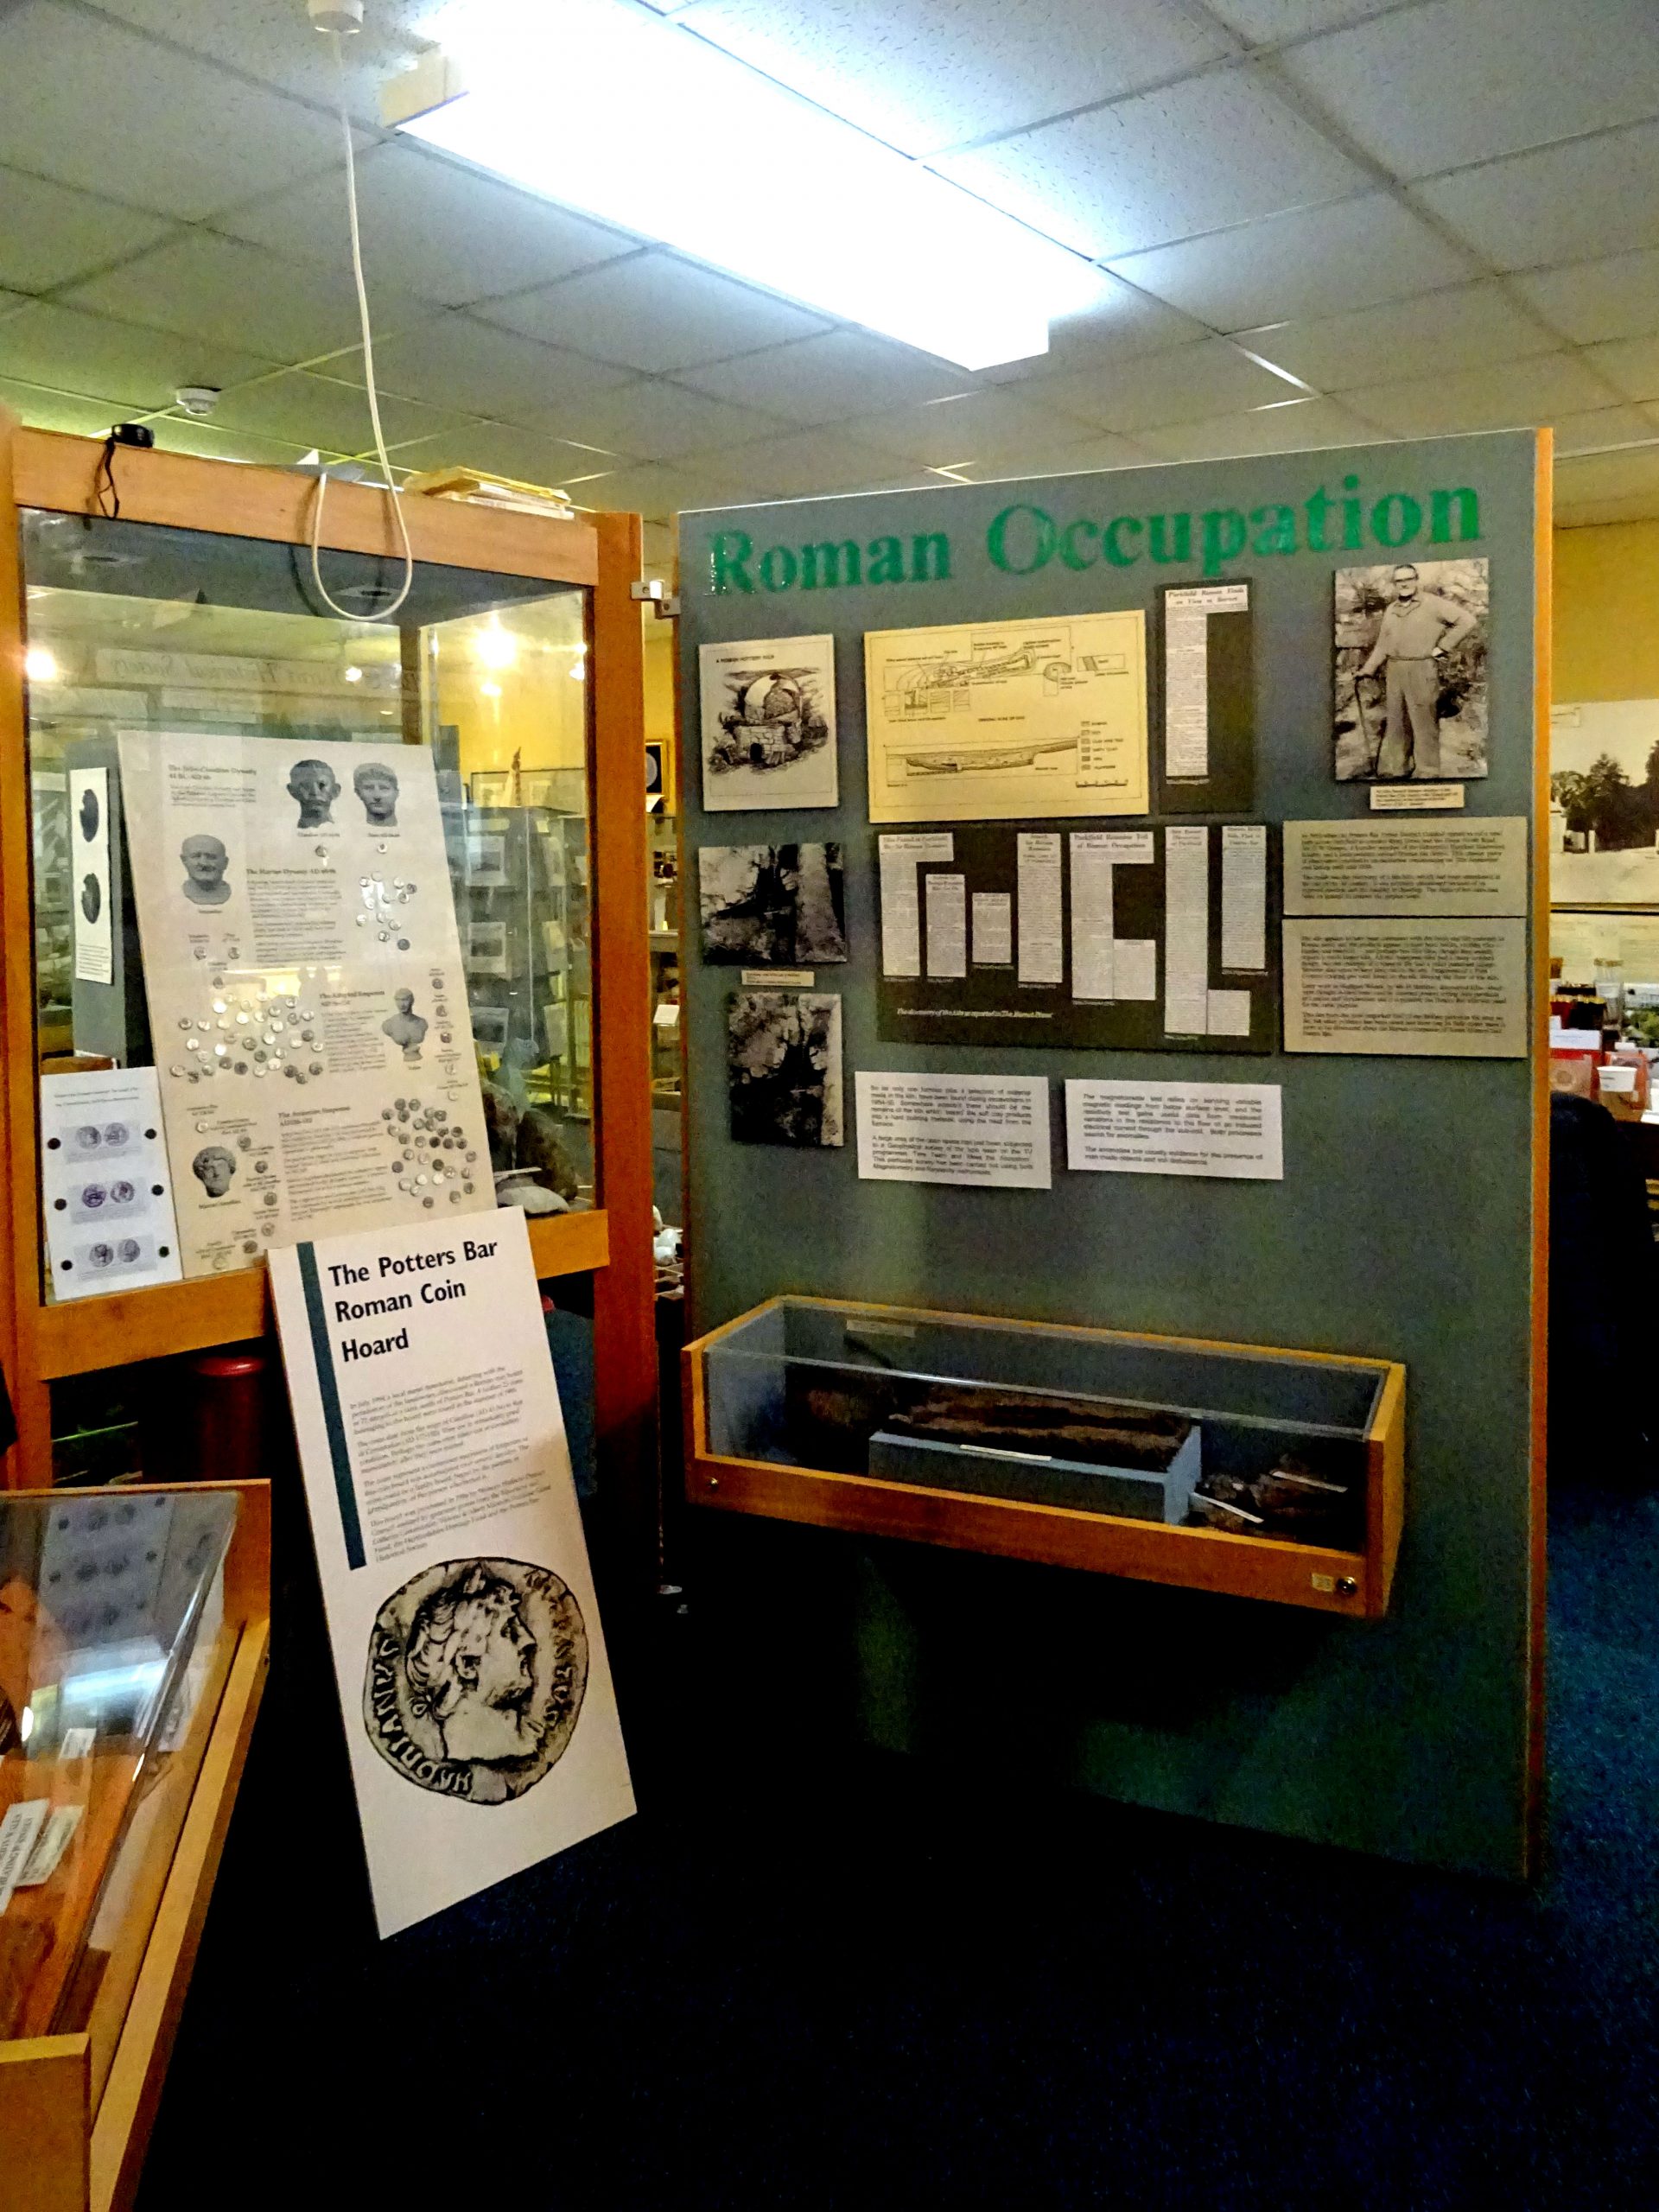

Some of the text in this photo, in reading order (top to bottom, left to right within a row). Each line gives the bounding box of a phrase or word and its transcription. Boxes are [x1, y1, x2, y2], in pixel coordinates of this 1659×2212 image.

[703, 473, 1481, 597] Roman Occupation
[328, 1241, 498, 1287] The Potters Bar
[334, 1280, 467, 1323] Roman Coin
[341, 1328, 410, 1363] Hoard
